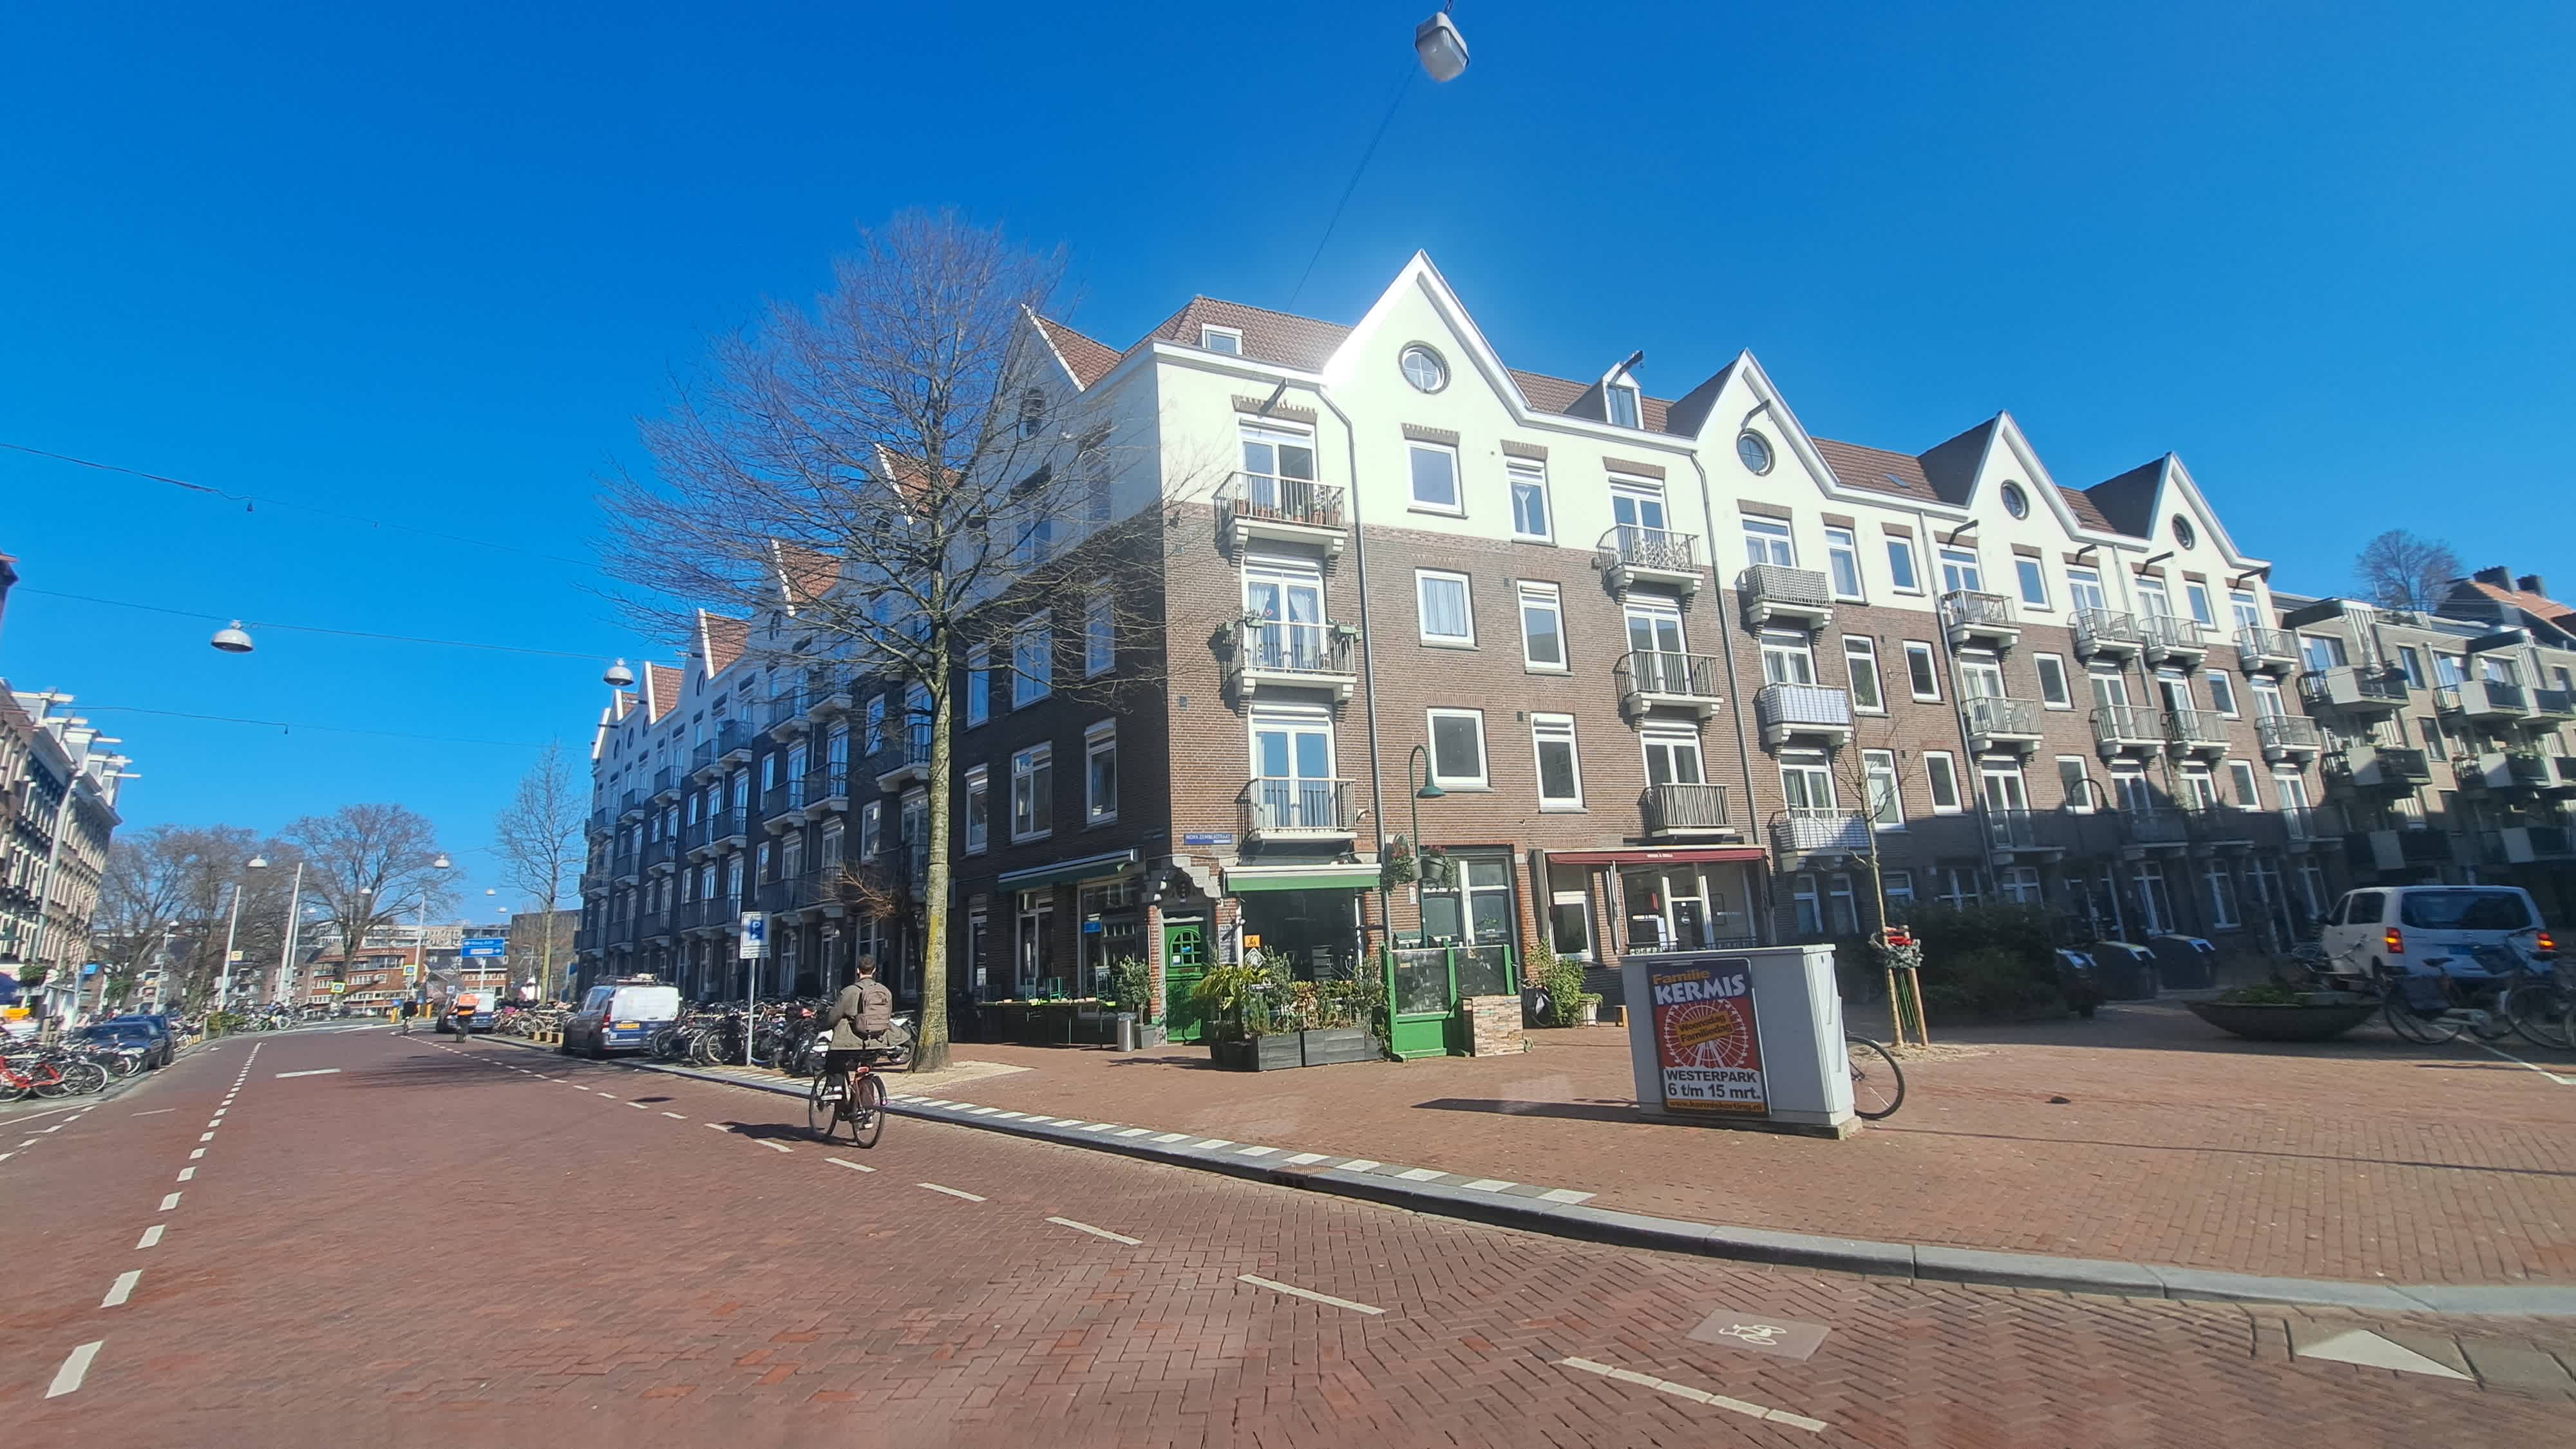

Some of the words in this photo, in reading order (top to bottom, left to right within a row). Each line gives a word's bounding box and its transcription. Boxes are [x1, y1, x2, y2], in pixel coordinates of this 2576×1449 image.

[1653, 969, 1711, 984] Familie
[1654, 974, 1746, 1005] KERMIS
[1680, 1014, 1726, 1032] Woensdag
[1680, 1024, 1732, 1042] Familiedag
[1666, 1070, 1757, 1083] WESTERPARK
[1668, 1083, 1677, 1096] 6
[1680, 1084, 1704, 1097] t/m
[1708, 1083, 1725, 1097] 15
[1730, 1086, 1761, 1099] mrt.
